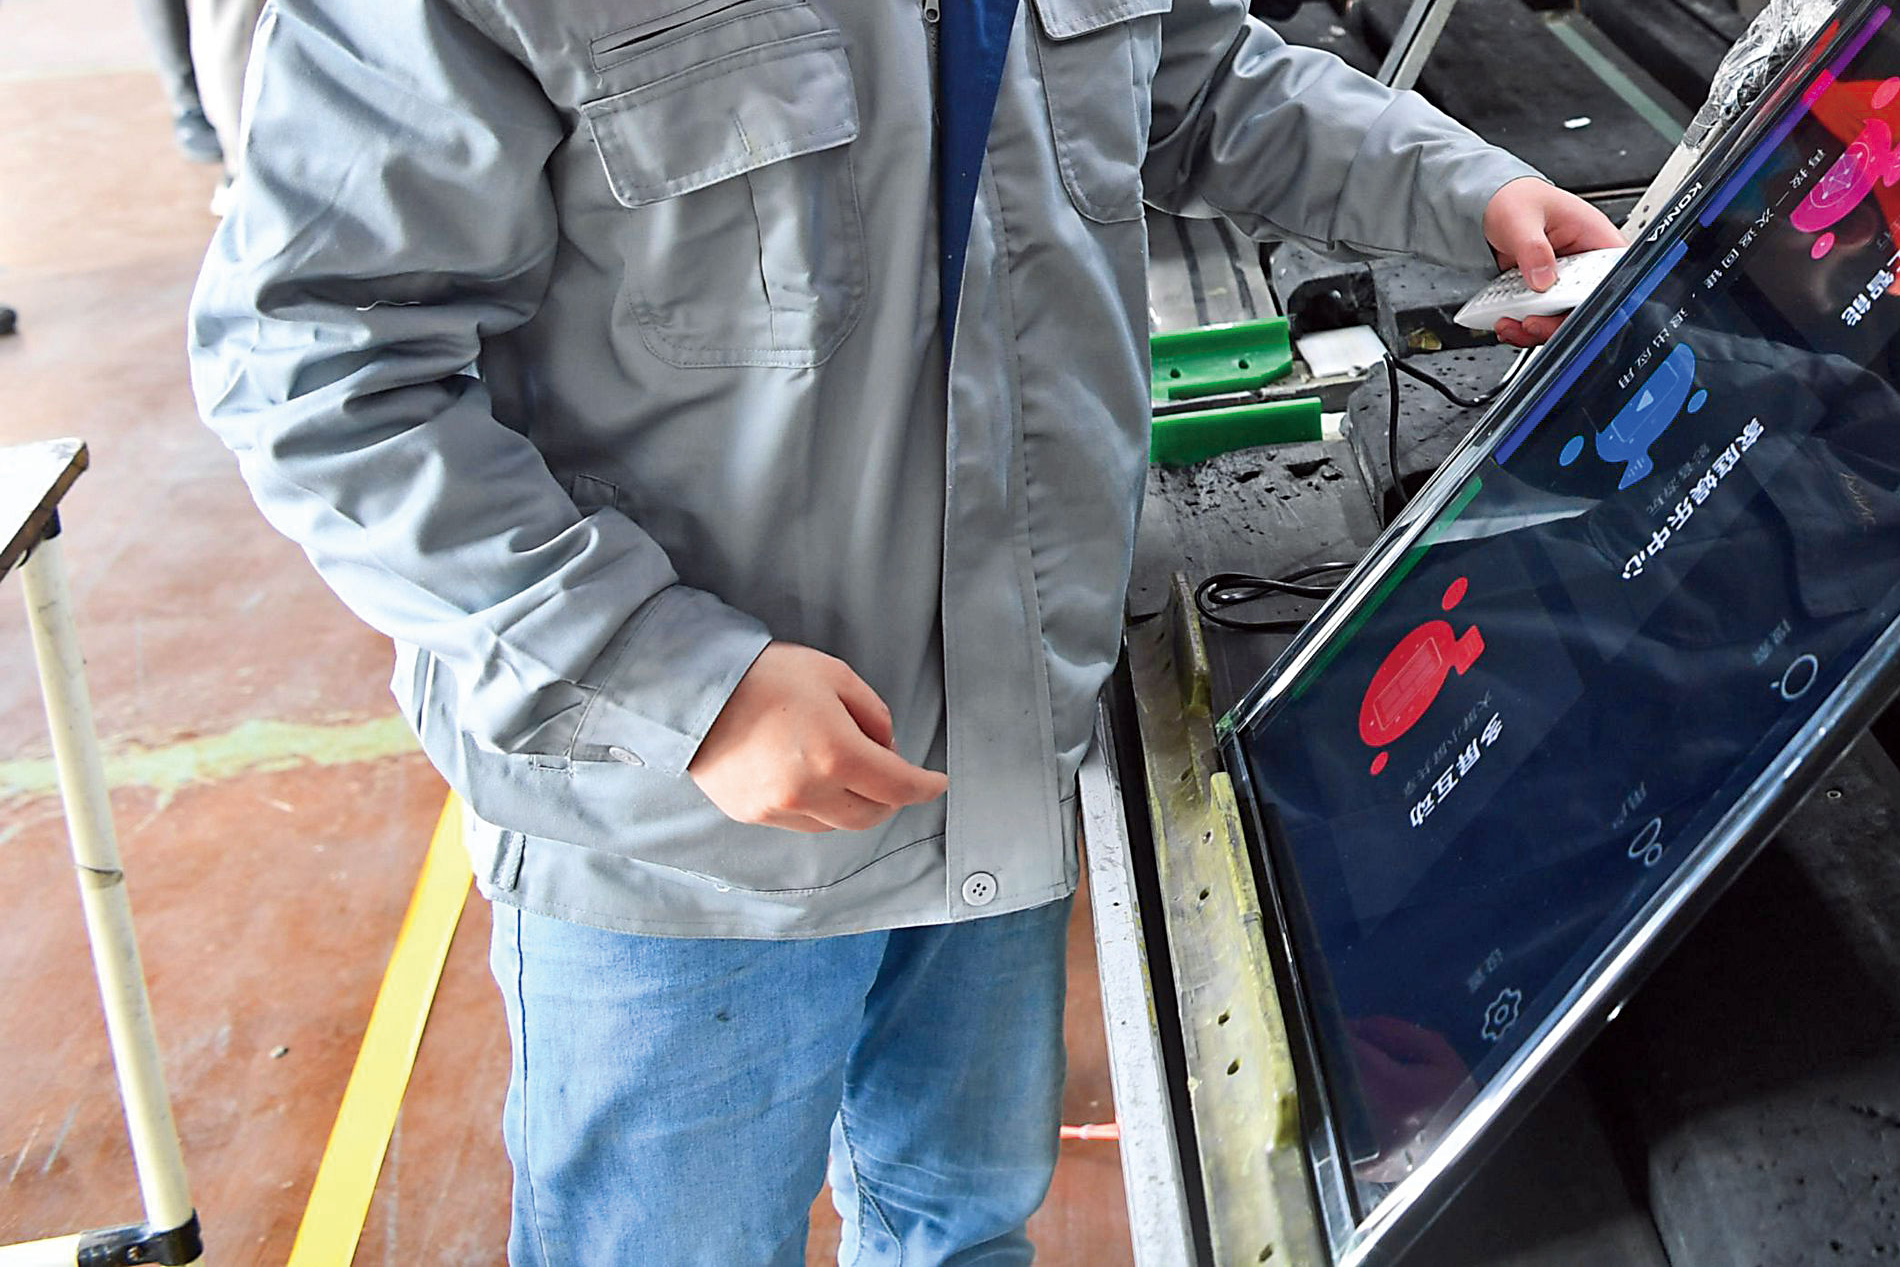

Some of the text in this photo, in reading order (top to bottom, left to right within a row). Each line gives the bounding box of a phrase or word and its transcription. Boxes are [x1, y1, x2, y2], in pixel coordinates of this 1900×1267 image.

[1645, 181, 1703, 242] KONKA
[1623, 418, 1764, 579] 家庭娱乐中心
[1410, 713, 1502, 827] 多屏互动
